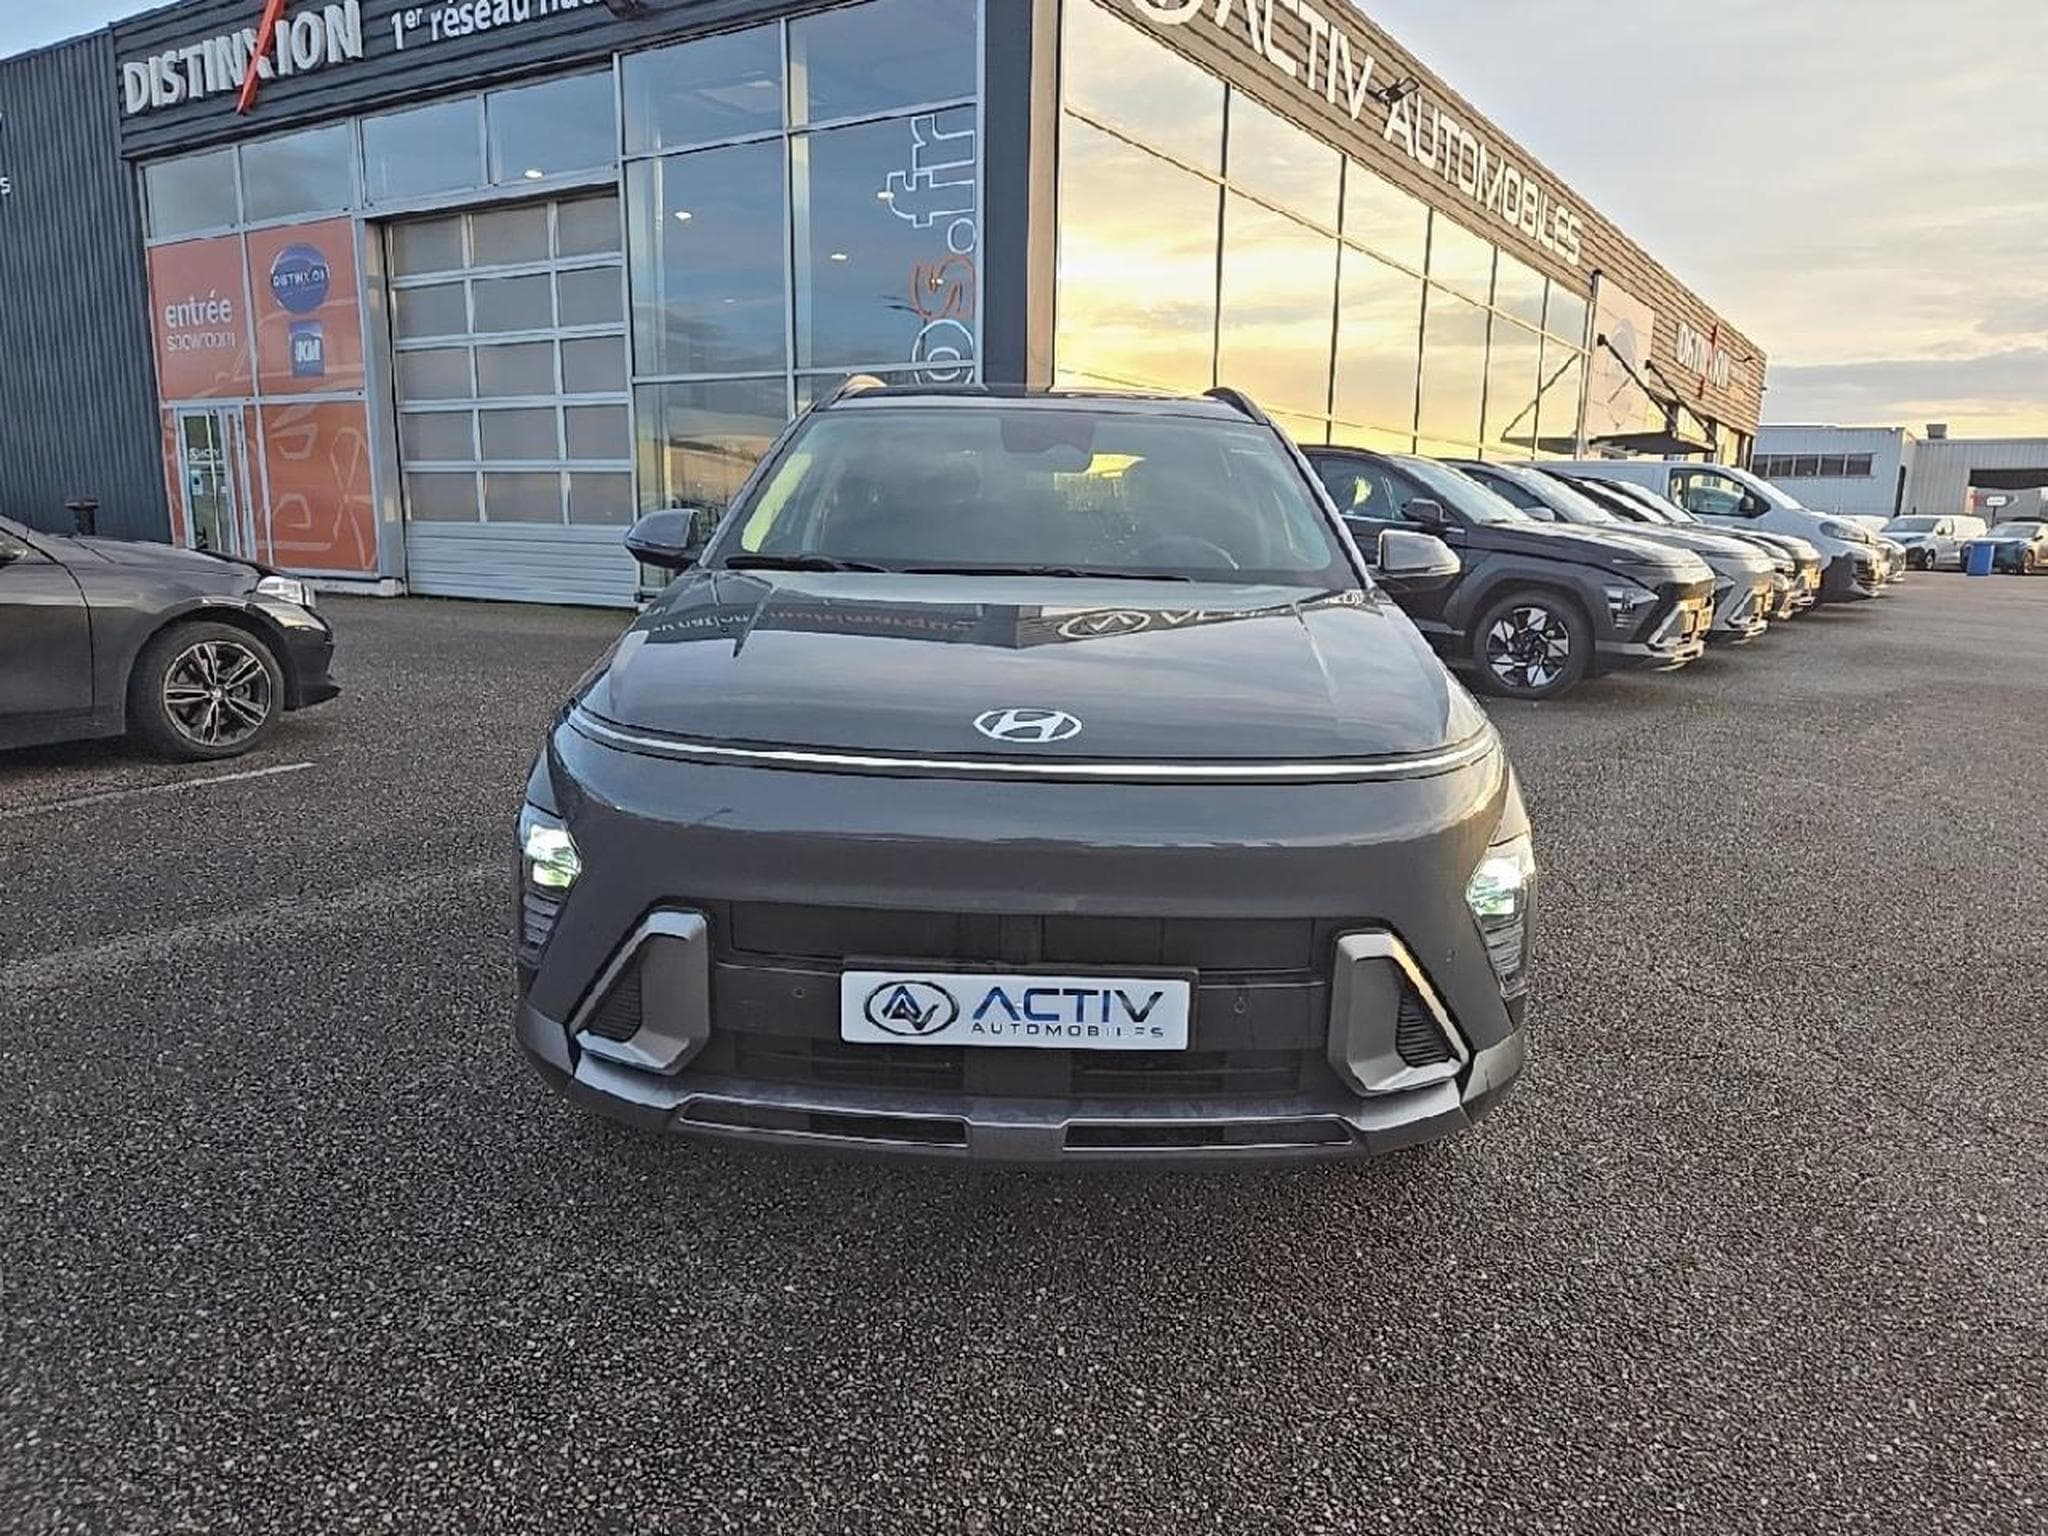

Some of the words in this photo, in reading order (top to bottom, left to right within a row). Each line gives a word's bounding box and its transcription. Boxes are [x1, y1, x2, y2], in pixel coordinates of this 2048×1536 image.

[1384, 92, 1583, 266] AUTOMOBILES
[165, 289, 232, 327] entrée
[972, 986, 1164, 1023] ACTIV
[971, 1022, 1164, 1039] AUTOMOBILES
